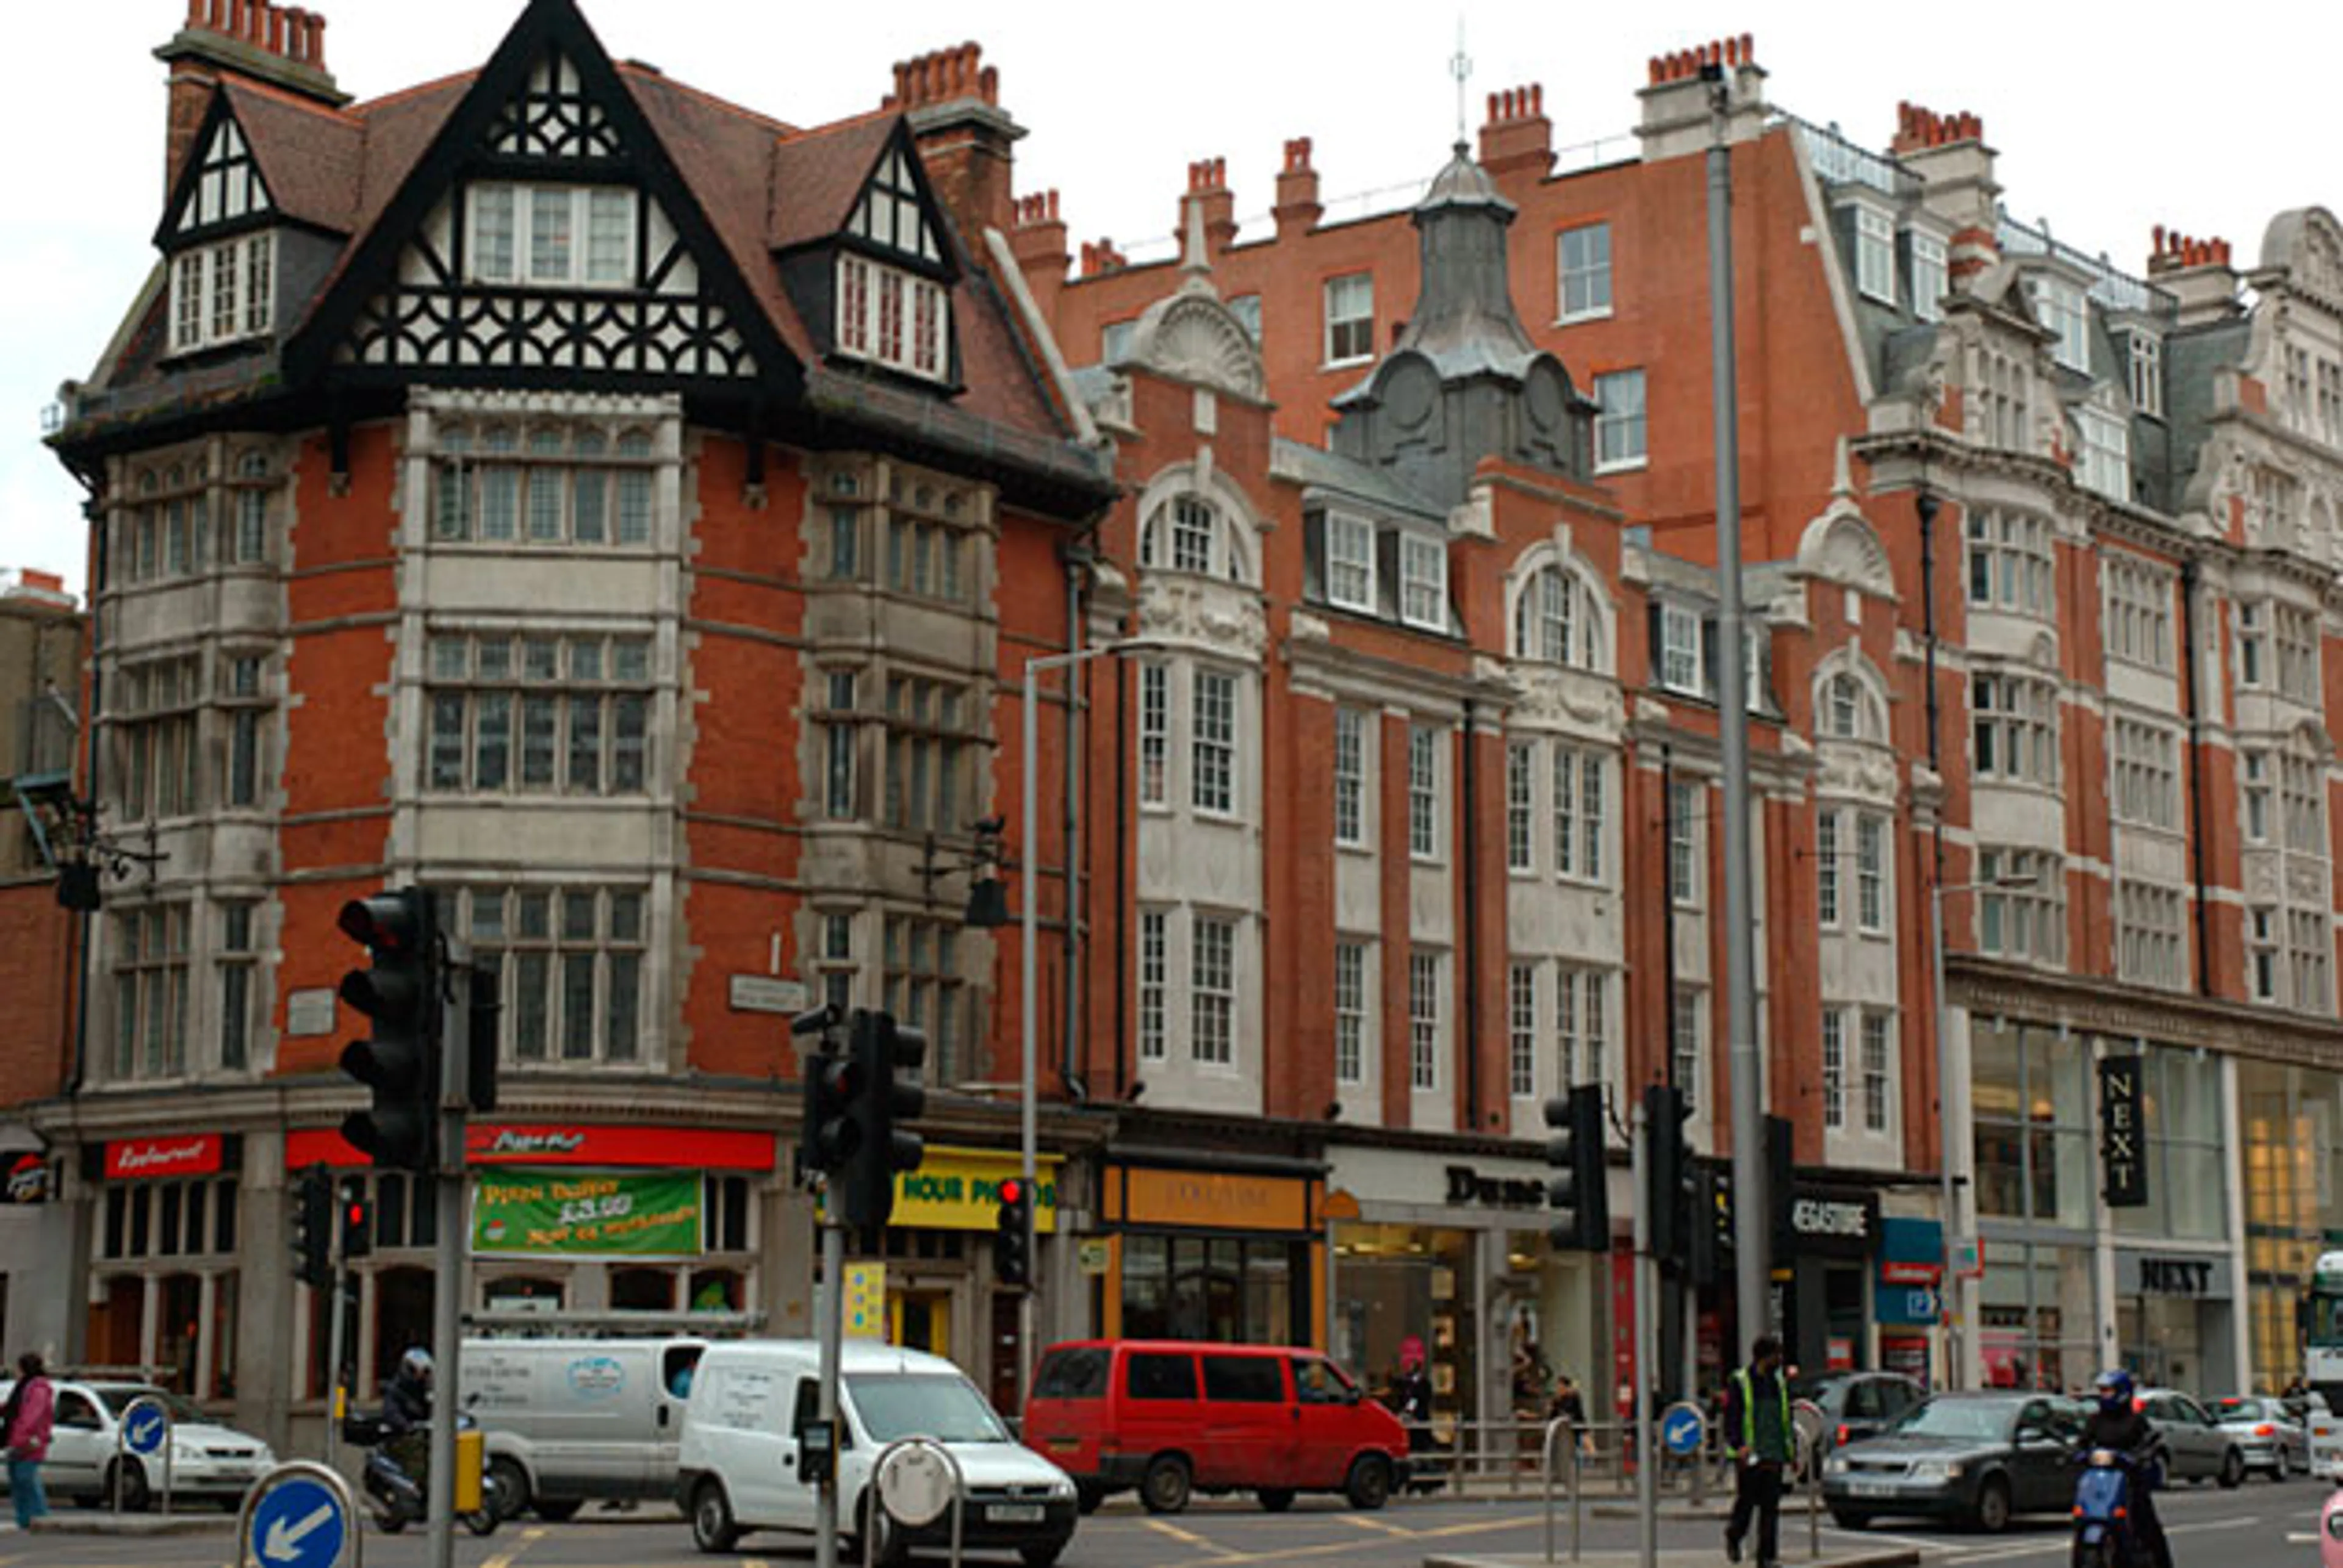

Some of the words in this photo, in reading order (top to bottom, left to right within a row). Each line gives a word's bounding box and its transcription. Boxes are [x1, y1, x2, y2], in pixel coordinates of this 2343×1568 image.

[2107, 1074, 2135, 1189] NEXT
[904, 1175, 963, 1203] HOUR
[2140, 1257, 2213, 1292] NEXT
